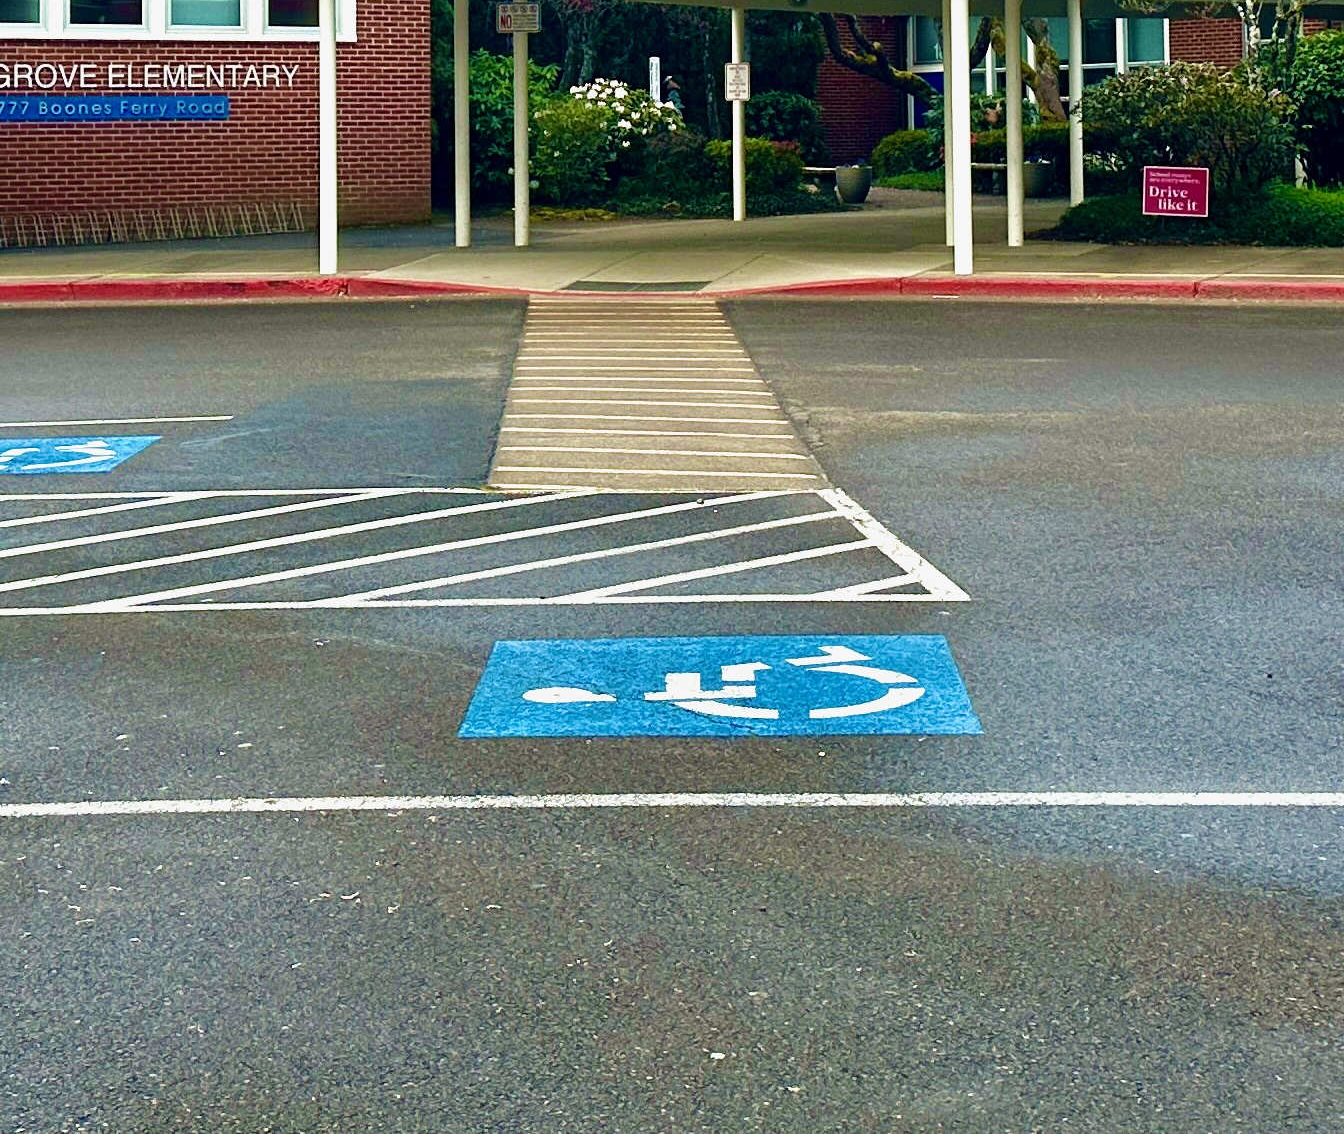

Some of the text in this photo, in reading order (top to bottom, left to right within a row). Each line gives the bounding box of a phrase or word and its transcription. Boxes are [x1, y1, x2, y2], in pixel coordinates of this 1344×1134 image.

[108, 64, 300, 89] ELEMENTARY
[38, 101, 112, 116] Boones
[120, 100, 168, 117] Ferry
[176, 99, 225, 115] Road
[1149, 185, 1188, 198] Drive
[1158, 198, 1199, 211] like it
